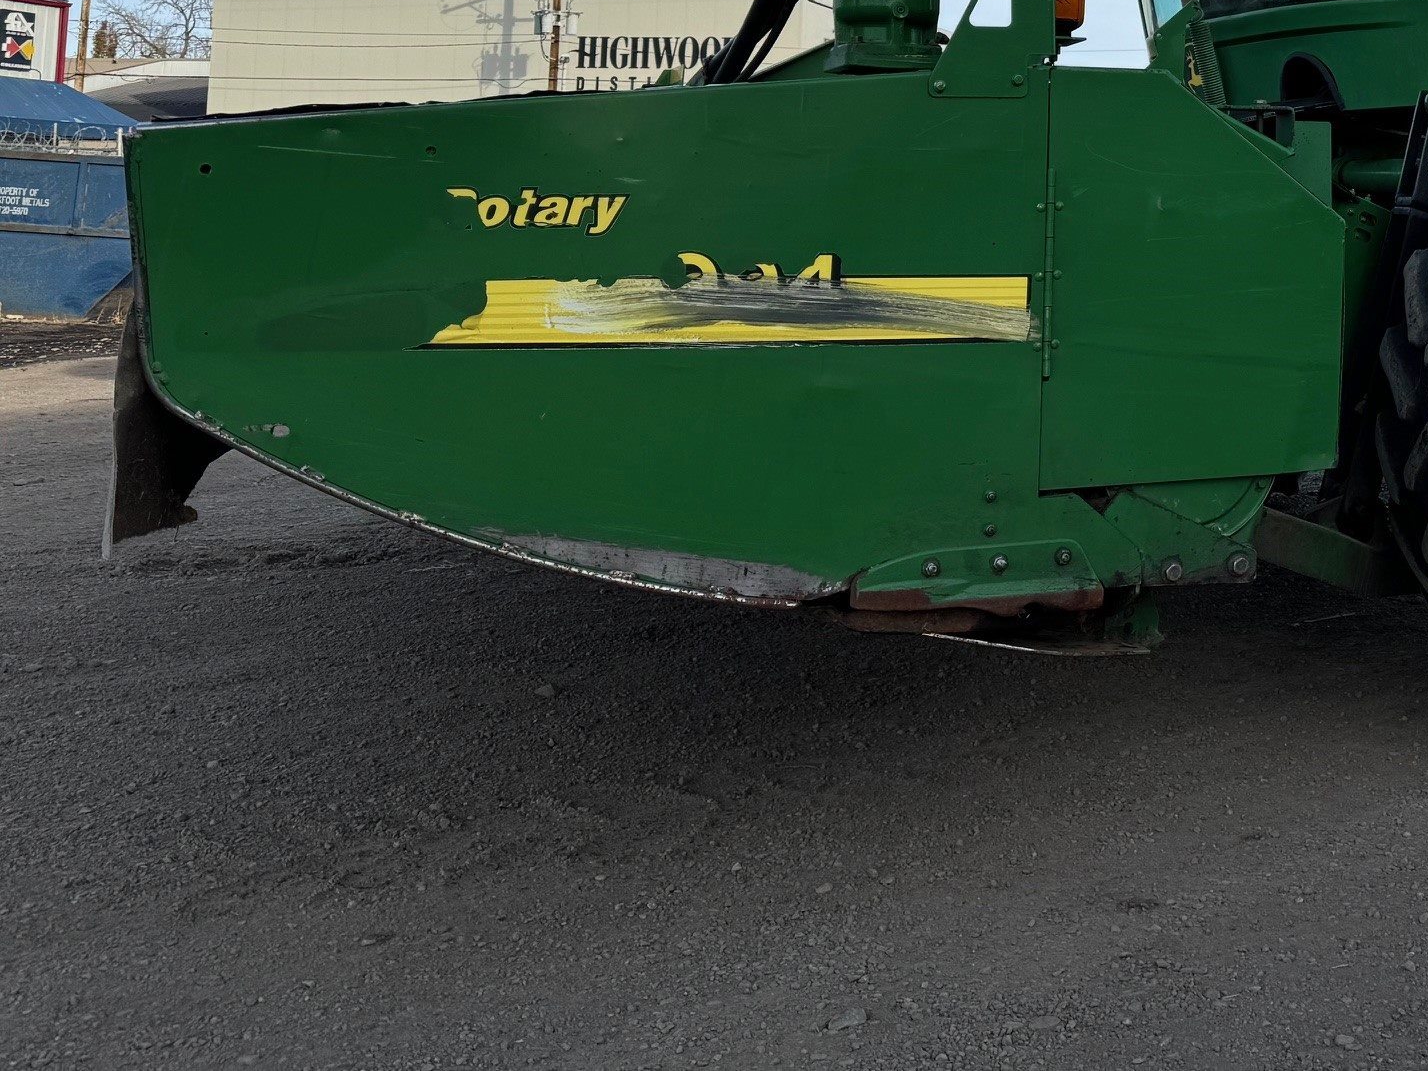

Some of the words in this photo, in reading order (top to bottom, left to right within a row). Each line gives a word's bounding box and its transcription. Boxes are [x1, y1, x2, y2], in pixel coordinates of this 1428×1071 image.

[575, 35, 734, 70] HIGHWOO
[22, 197, 50, 207] METALS
[29, 188, 39, 197] OF
[446, 186, 630, 237] otary
